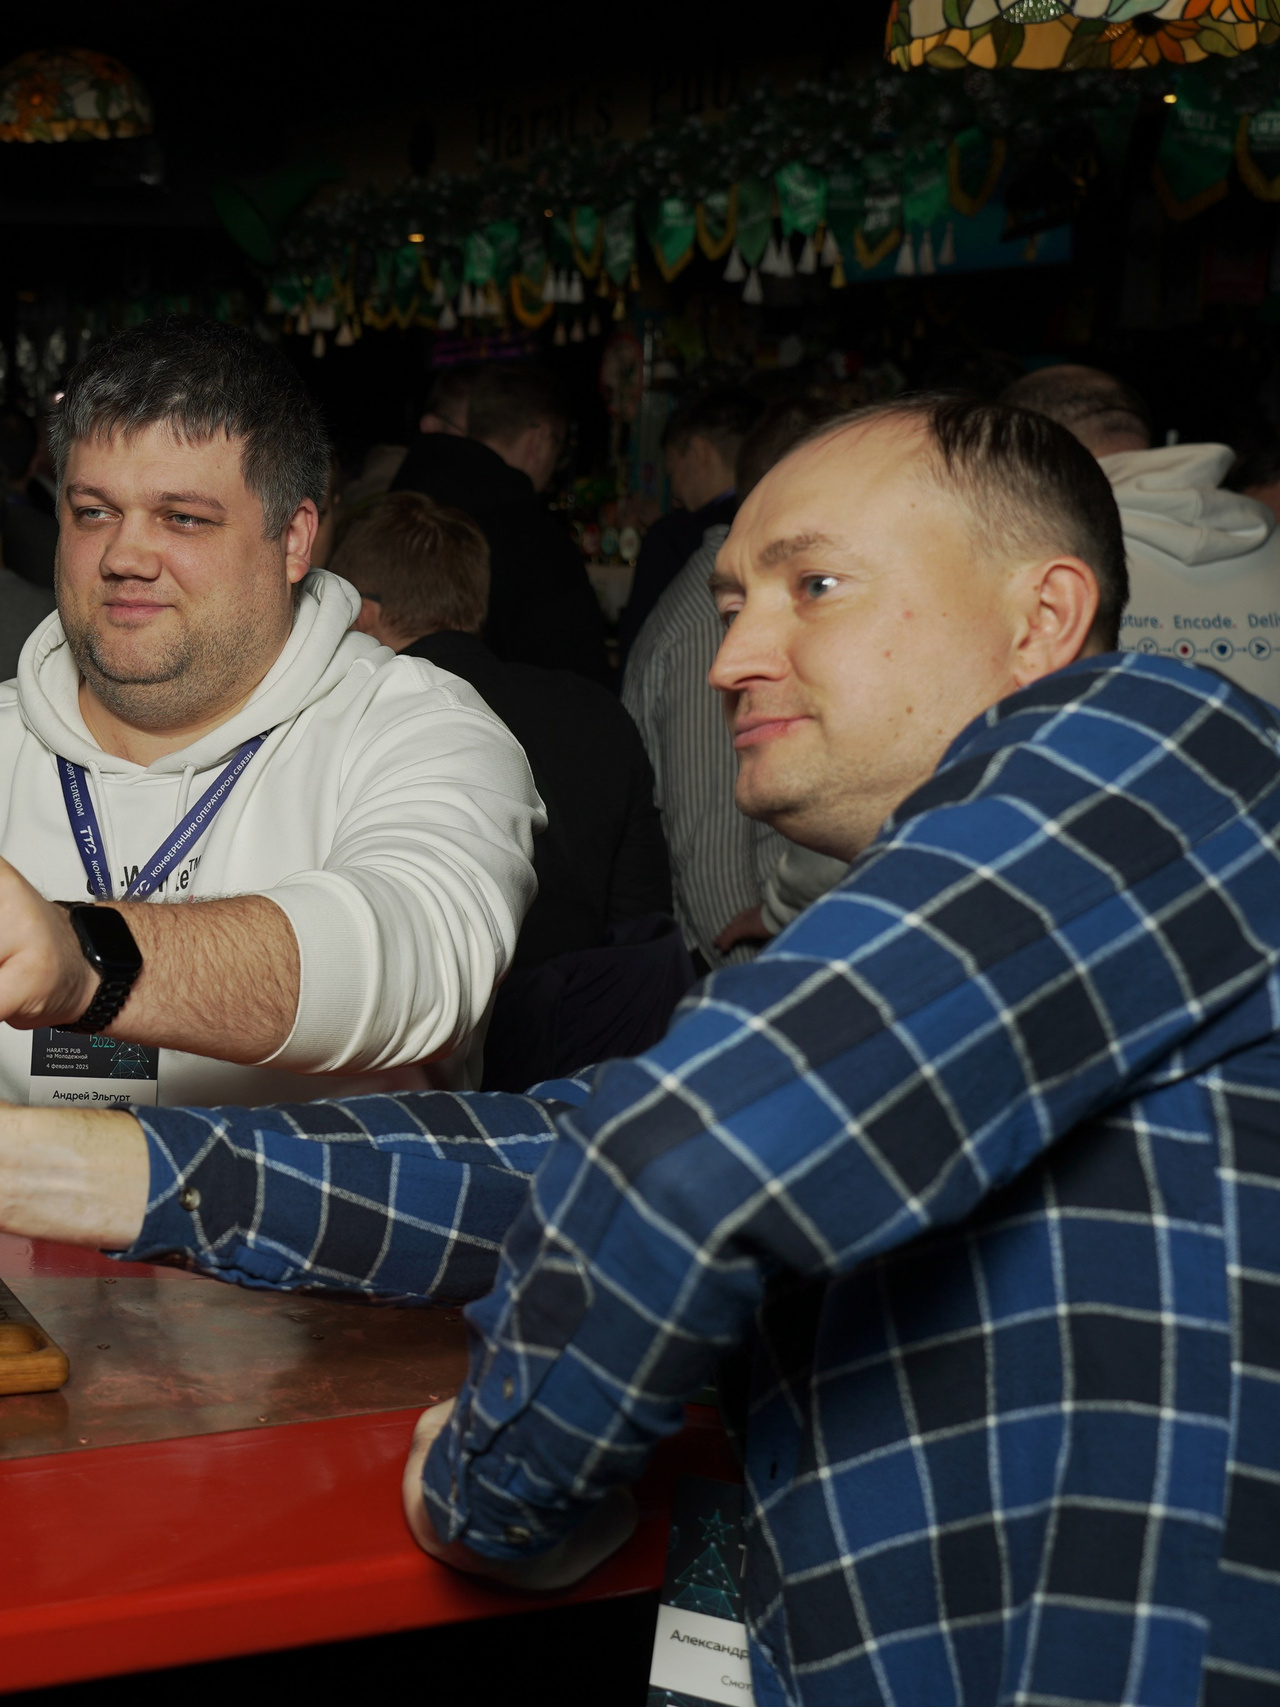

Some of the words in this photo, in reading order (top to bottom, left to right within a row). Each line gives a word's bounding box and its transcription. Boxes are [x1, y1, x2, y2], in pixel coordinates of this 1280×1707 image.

[1173, 613, 1237, 630] Encode.
[70, 780, 85, 817] ТЕЛЕКОМ
[150, 822, 198, 878] КОНФЕРЕНЦИЯ
[195, 774, 235, 823] ОПЕРАТОРОВ
[233, 750, 254, 775] СВЯЗИ
[92, 1036, 116, 1048] 2025
[52, 1090, 90, 1102] Андрей
[91, 1091, 131, 1103] Эльгурт
[670, 1629, 749, 1660] Александр
